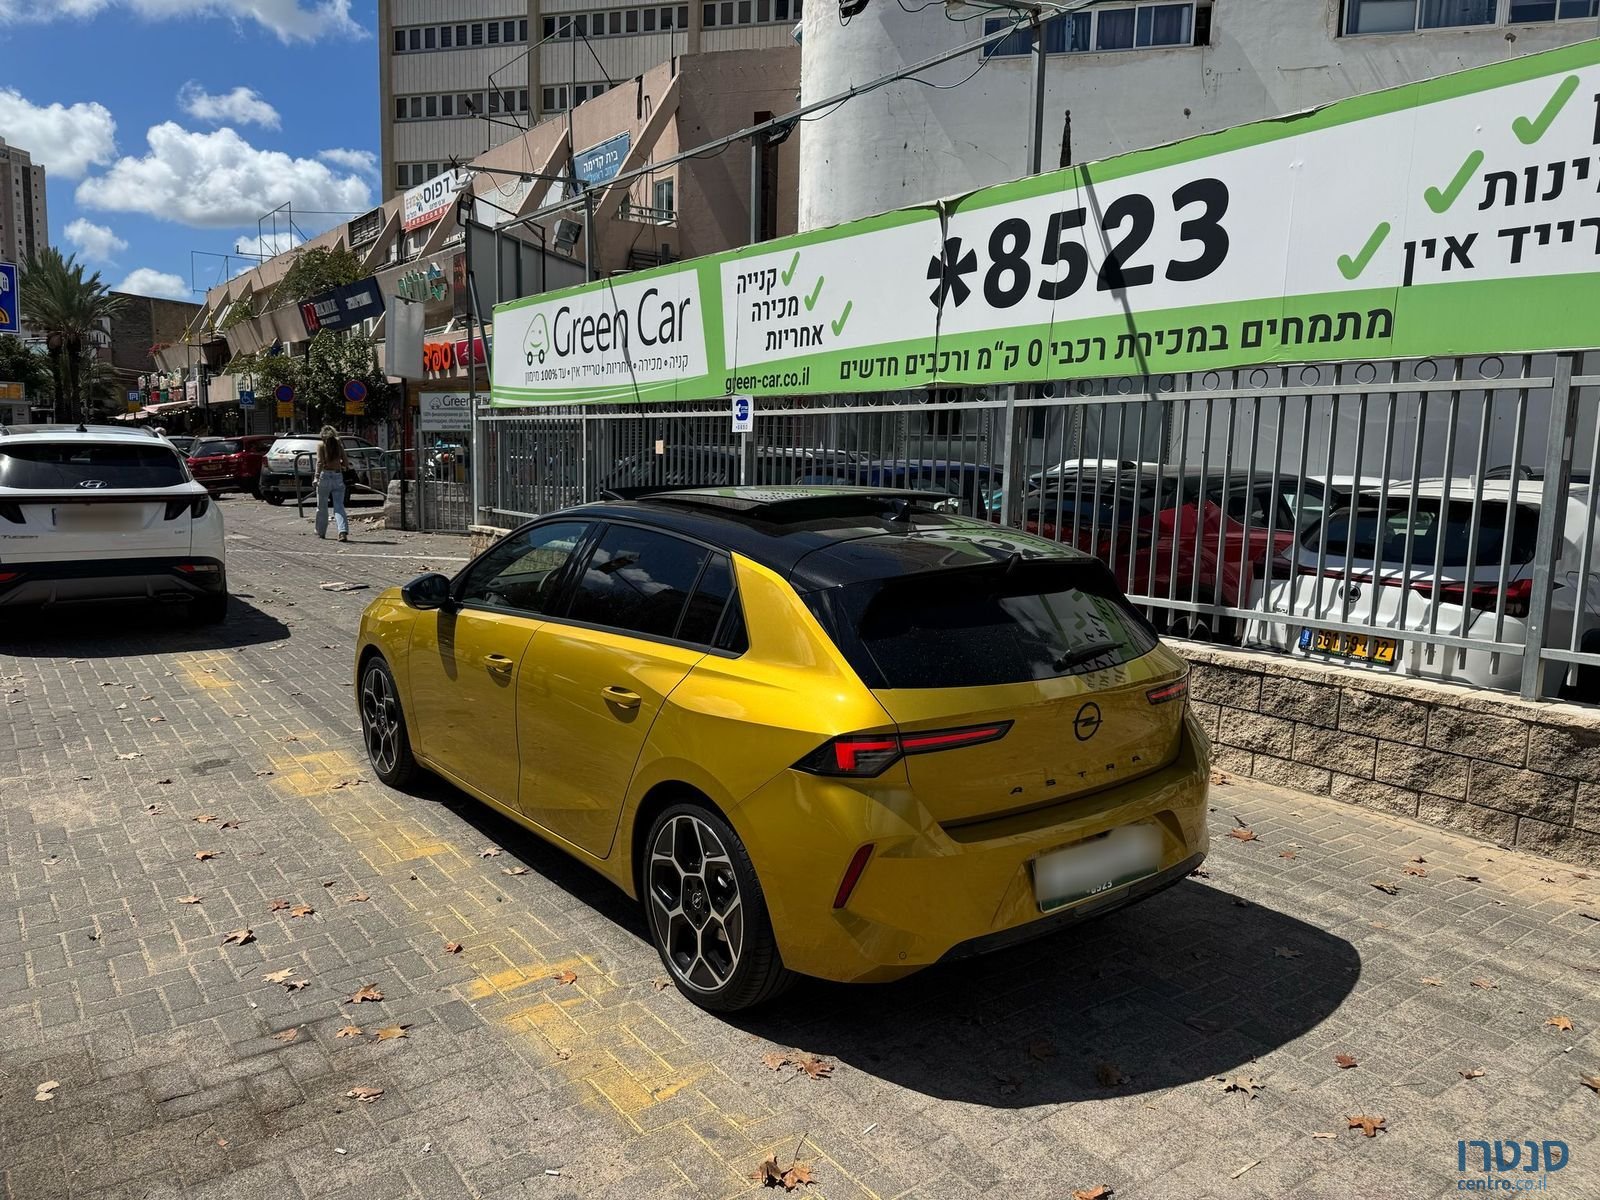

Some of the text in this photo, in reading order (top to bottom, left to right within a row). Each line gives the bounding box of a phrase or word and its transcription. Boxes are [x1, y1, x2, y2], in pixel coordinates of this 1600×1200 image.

[583, 151, 618, 174] בית קדימה
[424, 177, 450, 204] דפוס
[1478, 156, 1600, 211] ינות
[1403, 233, 1479, 287] אין
[737, 268, 777, 296] קנייה
[752, 295, 799, 322] מכירה
[553, 288, 691, 358] Green Car
[1241, 307, 1394, 349] מתמחים
[765, 324, 824, 352] אחריות
[1050, 336, 1105, 365] רכבי
[1115, 323, 1229, 360] במכירת
[638, 357, 663, 371] מכירה
[669, 354, 689, 373] קניה
[905, 349, 970, 375] ורכבים
[1027, 338, 1043, 368] 0
[541, 368, 558, 381] 100%
[606, 360, 632, 375] אחריות
[725, 366, 810, 395] green-car.co.il
[840, 355, 899, 380] חדשים
[1010, 755, 1141, 795] ASTRA
